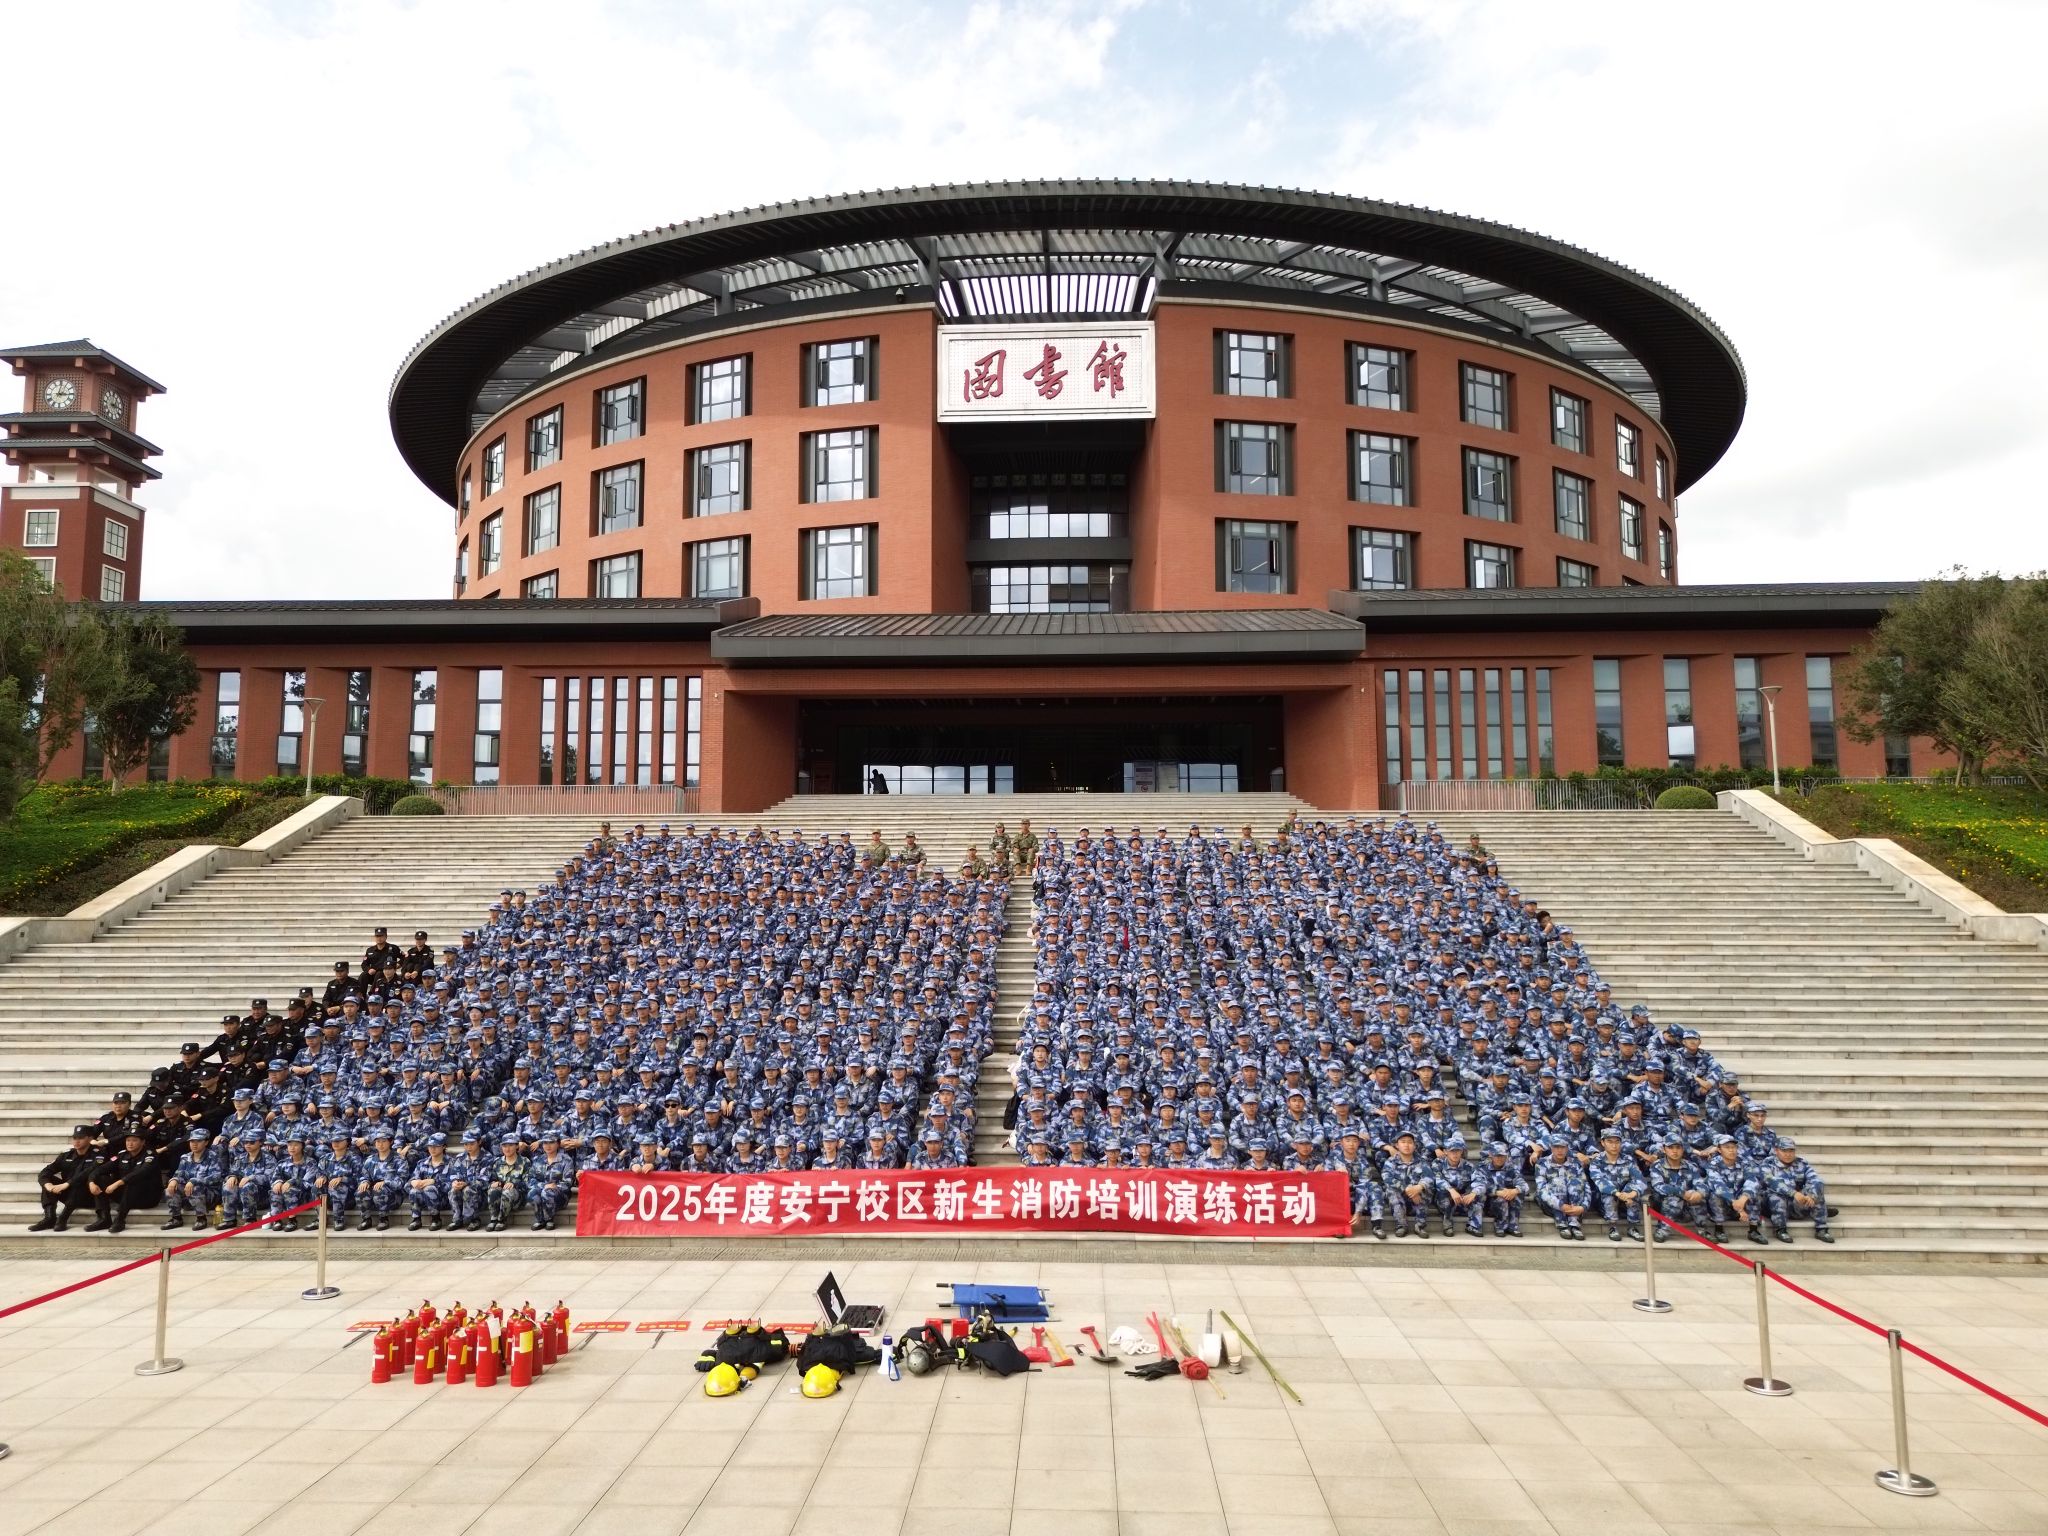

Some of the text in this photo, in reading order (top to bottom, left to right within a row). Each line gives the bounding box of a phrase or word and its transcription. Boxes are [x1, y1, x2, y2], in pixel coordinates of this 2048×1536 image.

[615, 1178, 1316, 1226] 2025年度安宁校区新生消防培训演练活动
